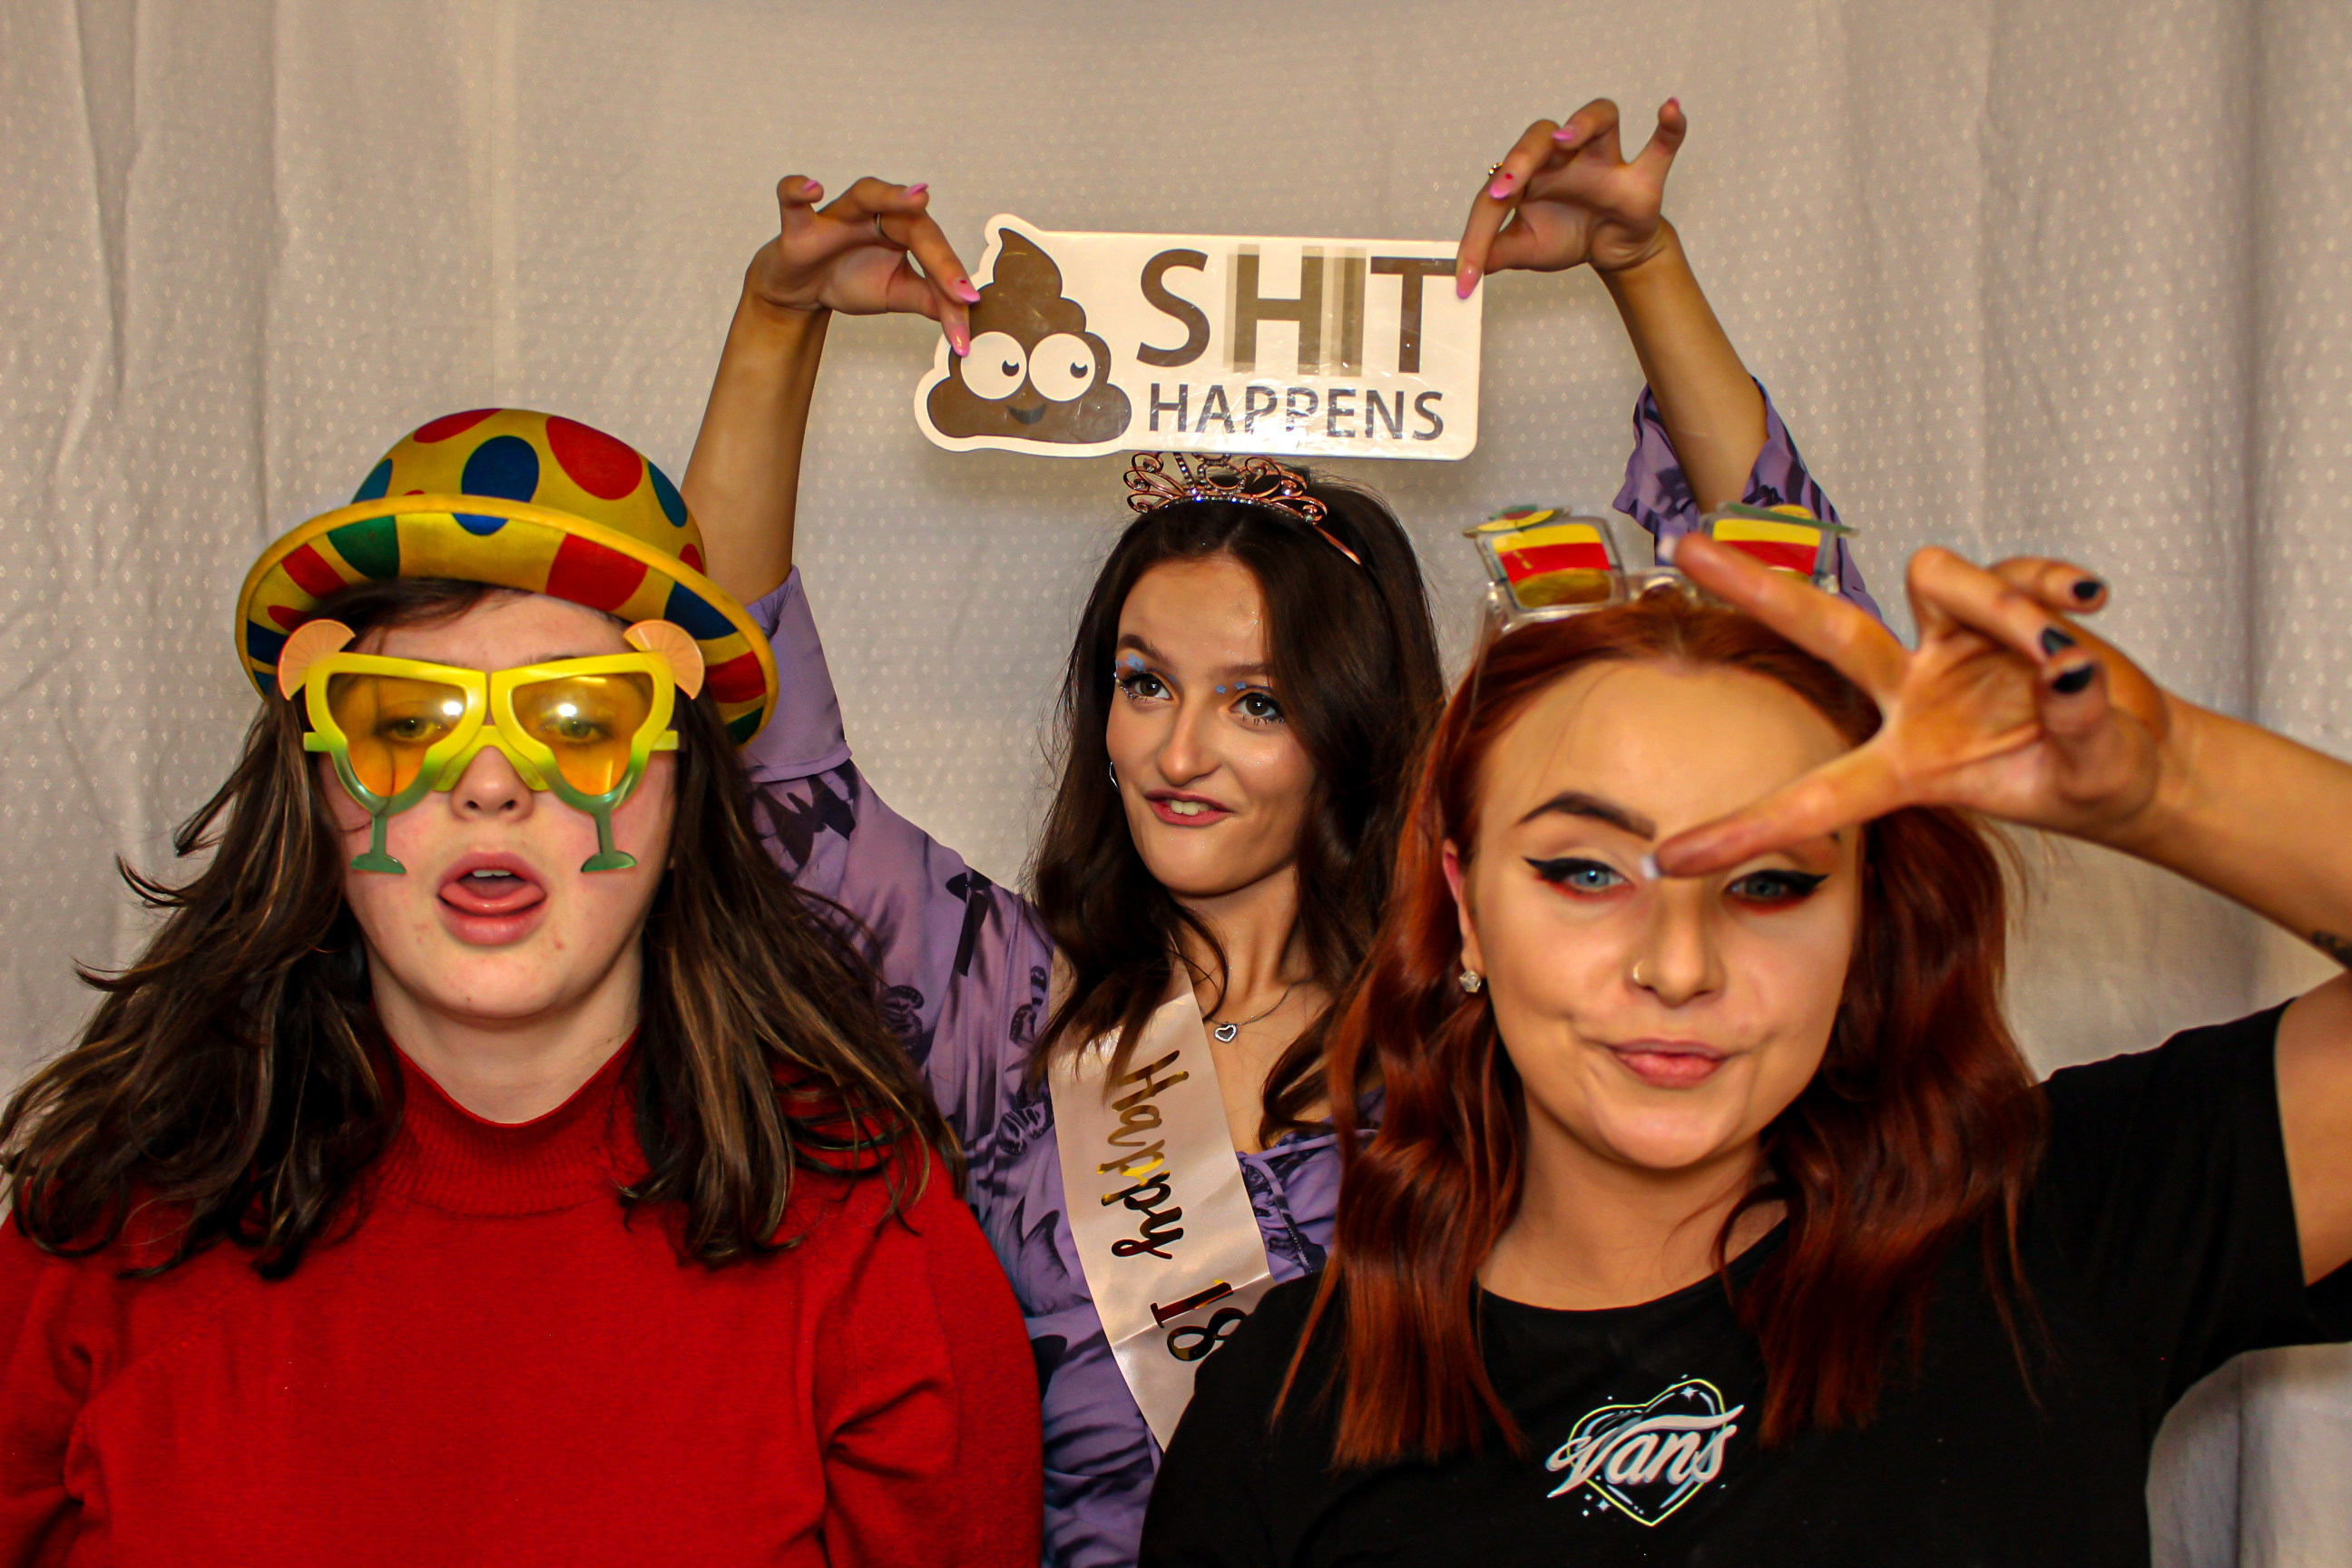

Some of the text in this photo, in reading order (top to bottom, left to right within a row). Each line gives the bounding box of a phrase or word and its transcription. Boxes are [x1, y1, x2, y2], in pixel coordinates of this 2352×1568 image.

[1135, 246, 1458, 375] SHIT
[1148, 381, 1445, 441] HAPPENS
[1096, 1049, 1190, 1260] Happy
[1545, 1404, 1745, 1498] Vans
